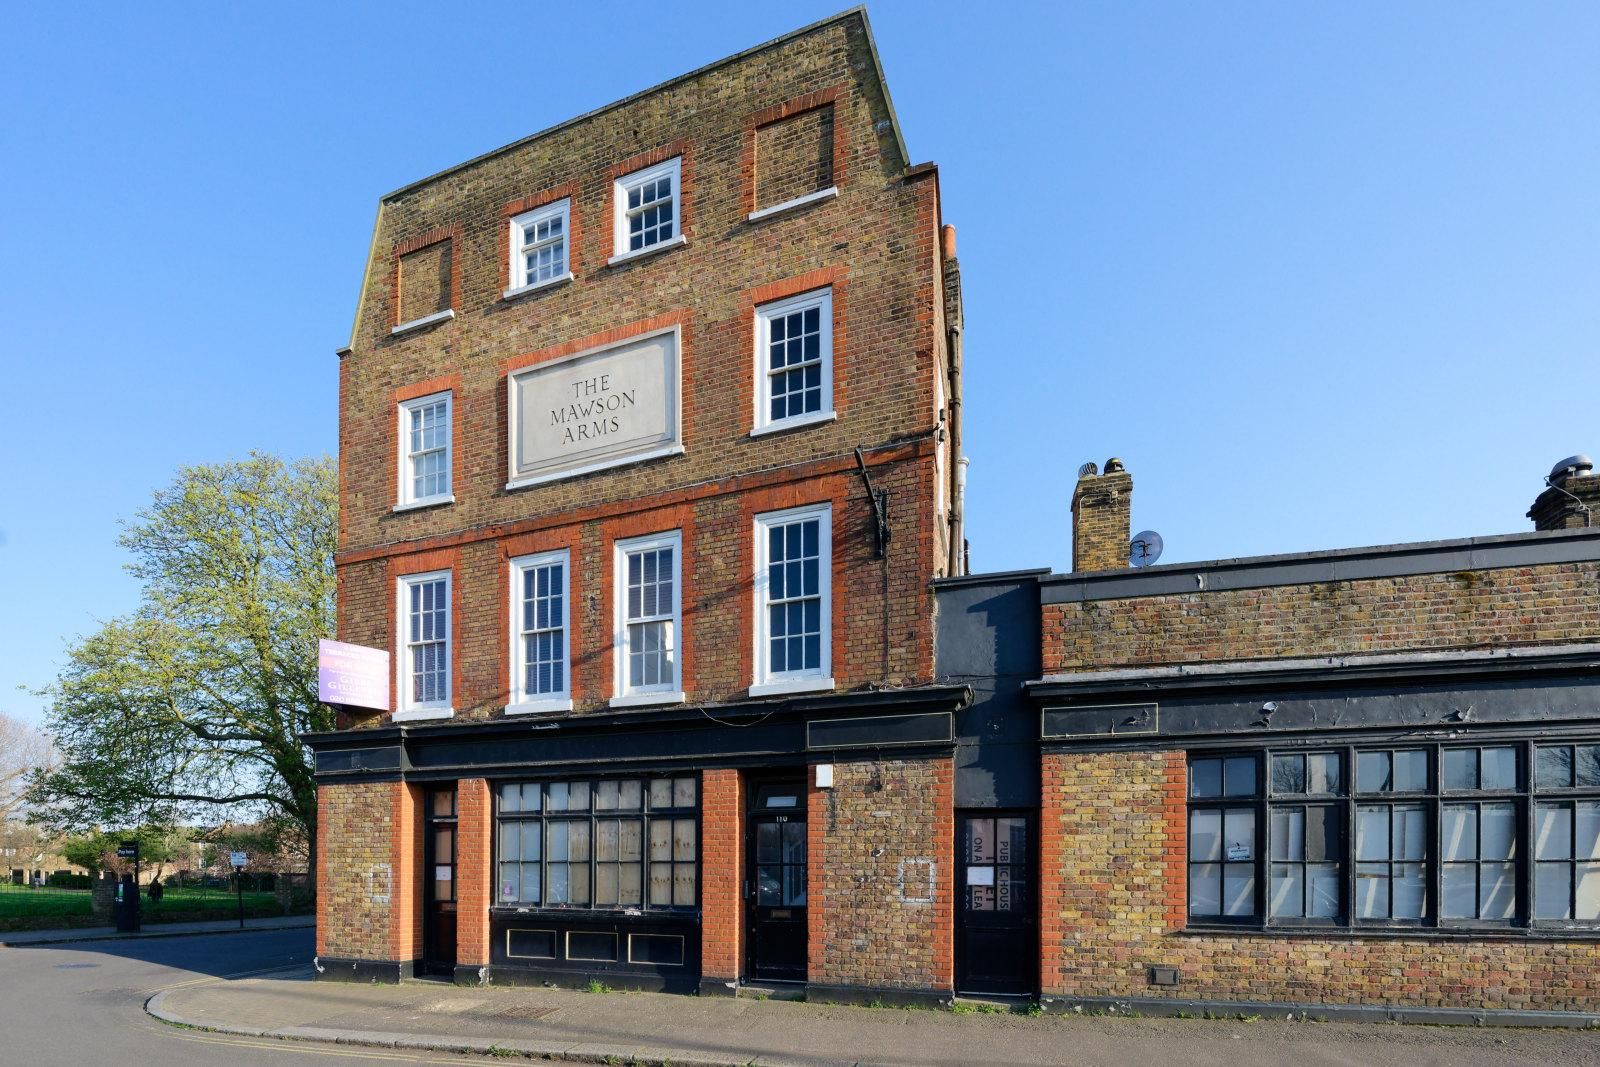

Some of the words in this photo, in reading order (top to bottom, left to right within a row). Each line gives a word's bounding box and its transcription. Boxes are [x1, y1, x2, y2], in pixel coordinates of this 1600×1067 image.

[572, 374, 609, 398] THE
[551, 389, 636, 426] MAWSON
[562, 416, 619, 444] ARMS
[974, 837, 983, 853] ON
[1000, 841, 1009, 878] PUBIC
[1000, 879, 1009, 911] HOUS
